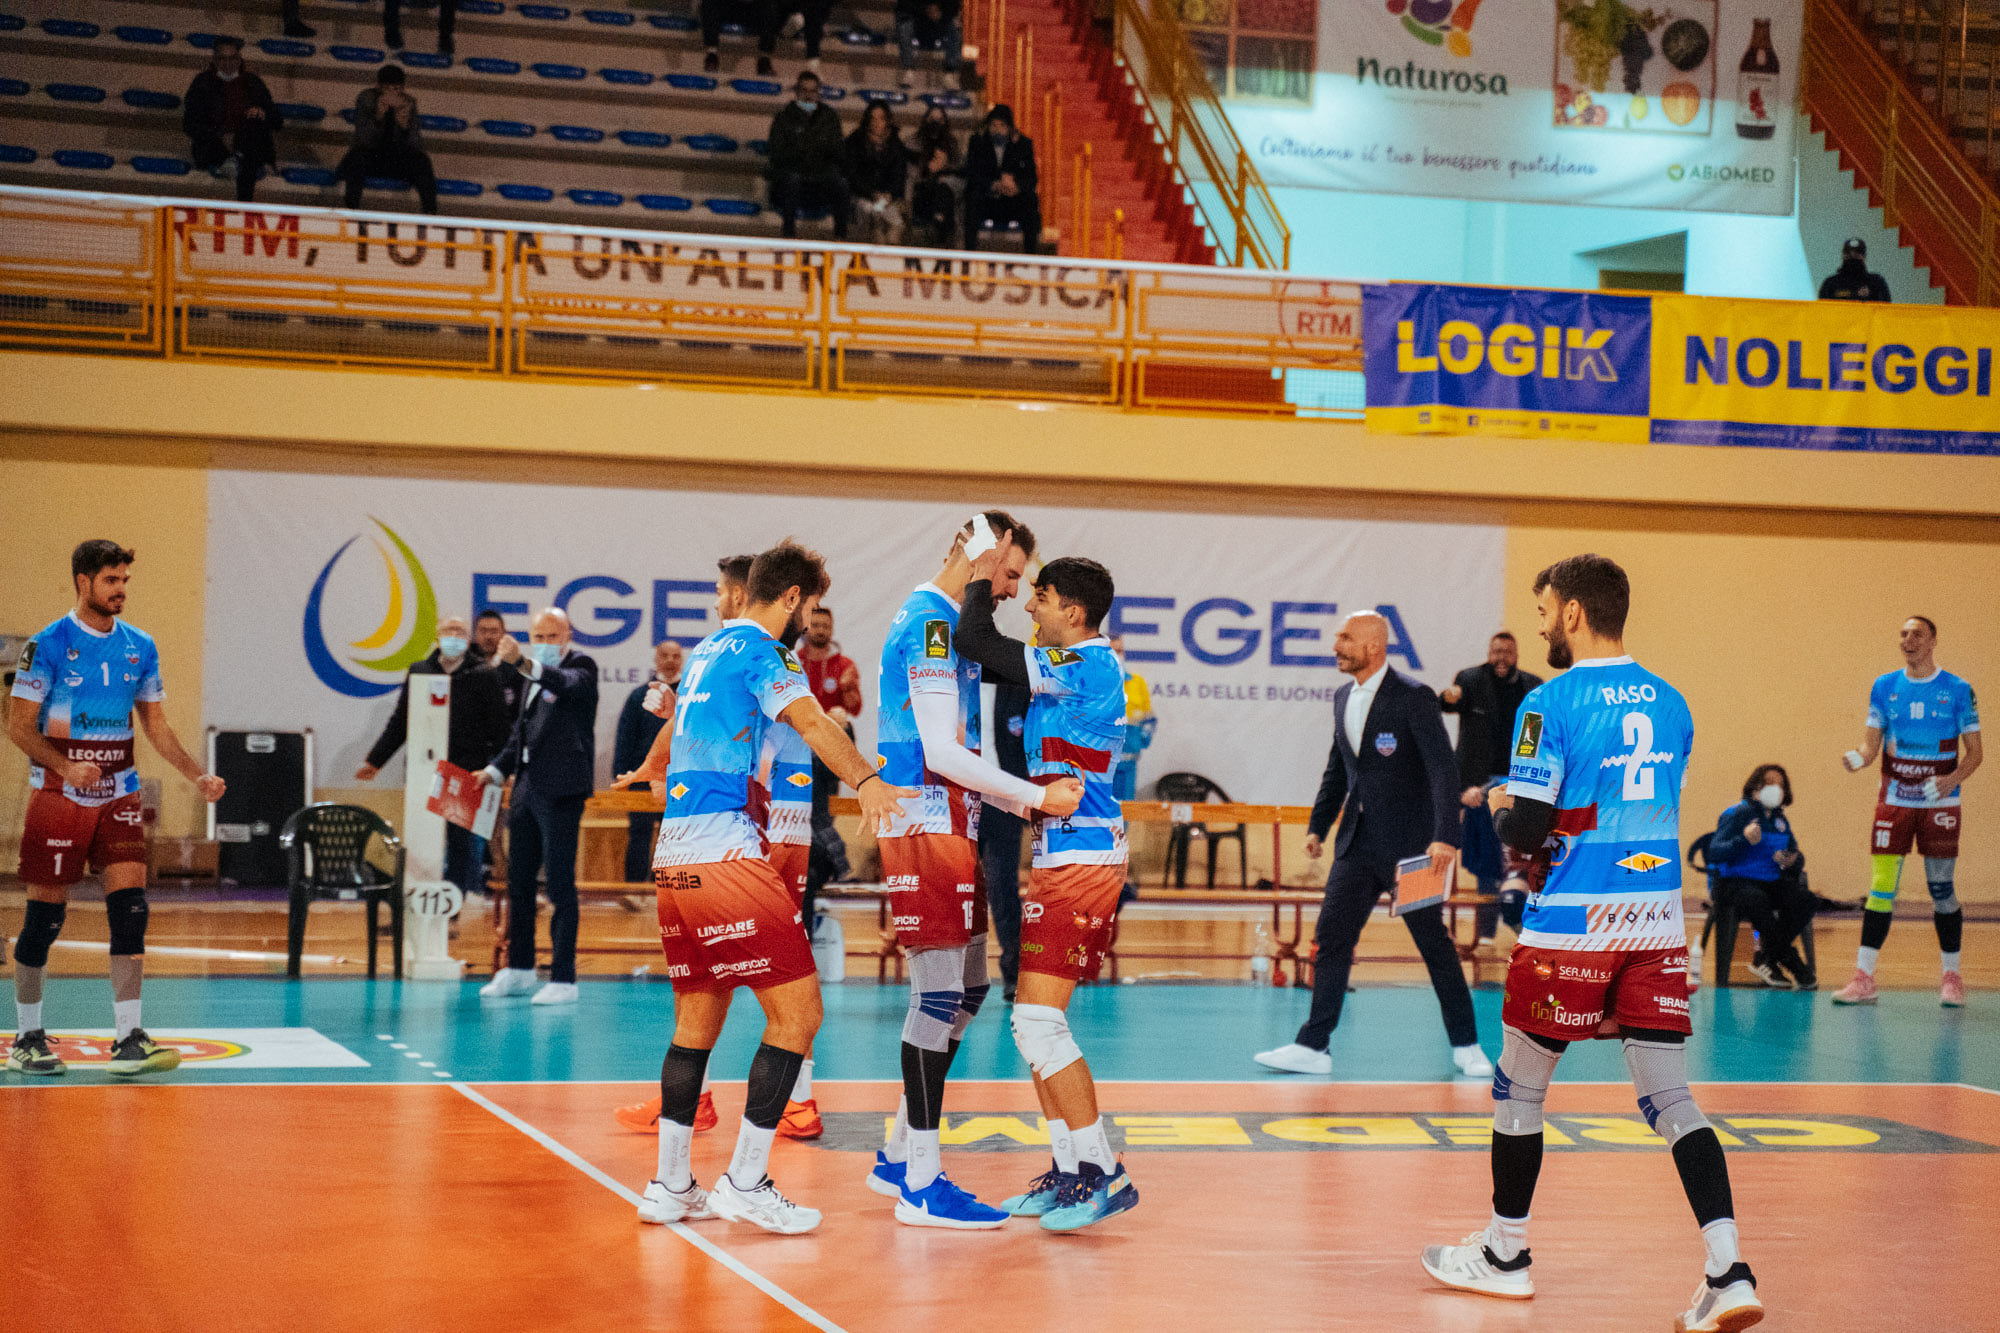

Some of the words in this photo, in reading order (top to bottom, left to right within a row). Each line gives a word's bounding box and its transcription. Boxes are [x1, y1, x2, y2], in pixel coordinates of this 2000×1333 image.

[1356, 57, 1510, 95] Naturosa
[902, 257, 1131, 310] MUSICA
[1297, 311, 1352, 336] RTM
[1397, 320, 1618, 382] LOGIK
[1684, 335, 1992, 397] NOLEGGI
[471, 572, 718, 648] EGE
[1107, 595, 1425, 671] EGEA
[100, 661, 110, 687] 1
[1152, 683, 1191, 698] ASA
[1199, 684, 1259, 700] DELLE
[1602, 684, 1657, 706] RASO
[67, 748, 126, 761] LEOCATA
[1621, 711, 1655, 802] 2
[1510, 764, 1552, 778] nergia
[54, 852, 63, 877] 1
[696, 919, 756, 938] LINEARE
[1607, 910, 1673, 924] BONK
